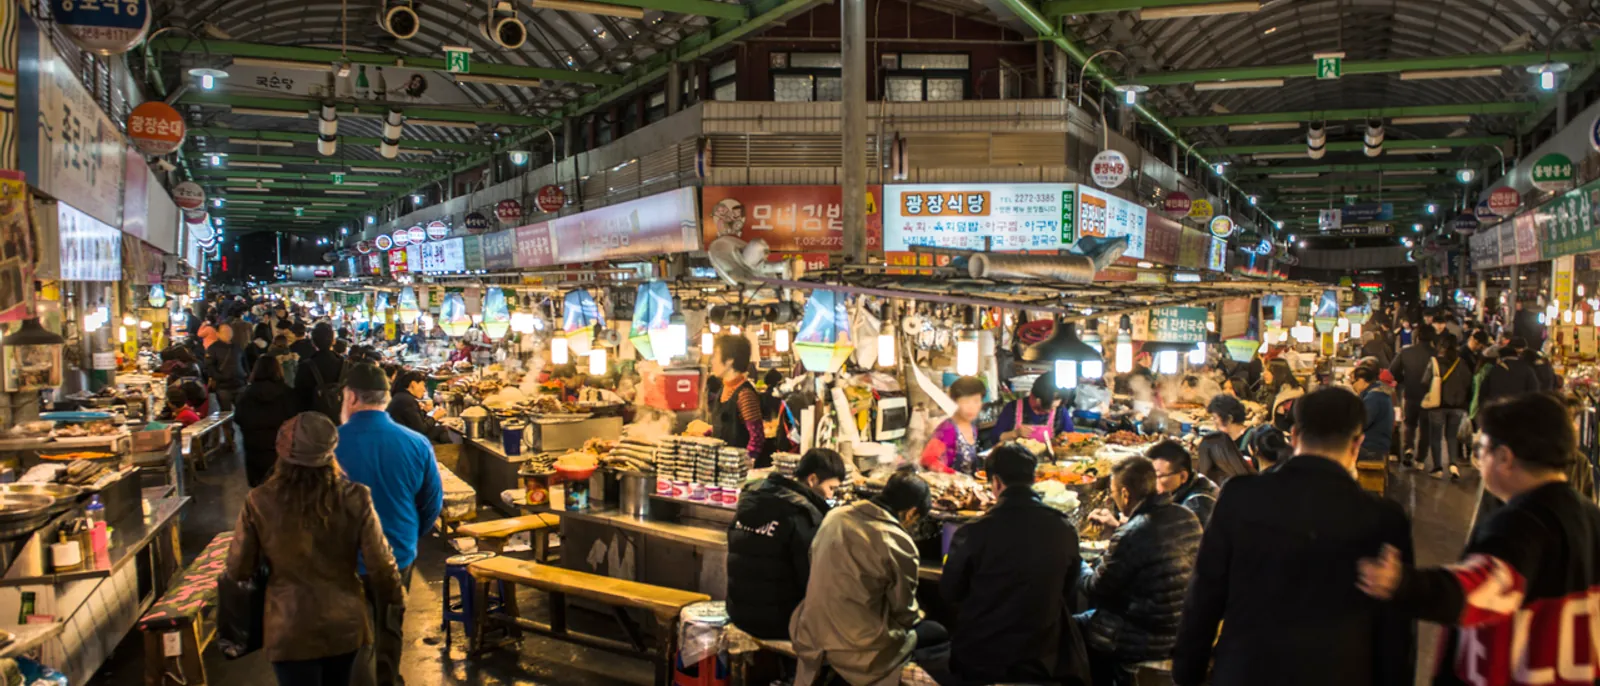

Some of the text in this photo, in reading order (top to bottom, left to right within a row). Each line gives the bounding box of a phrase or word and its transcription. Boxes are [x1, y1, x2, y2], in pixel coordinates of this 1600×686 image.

[256, 74, 295, 90] 국순당
[131, 116, 183, 136] 광장순대
[905, 194, 985, 215] 광장식당
[1014, 193, 1055, 203] 2272-3385
